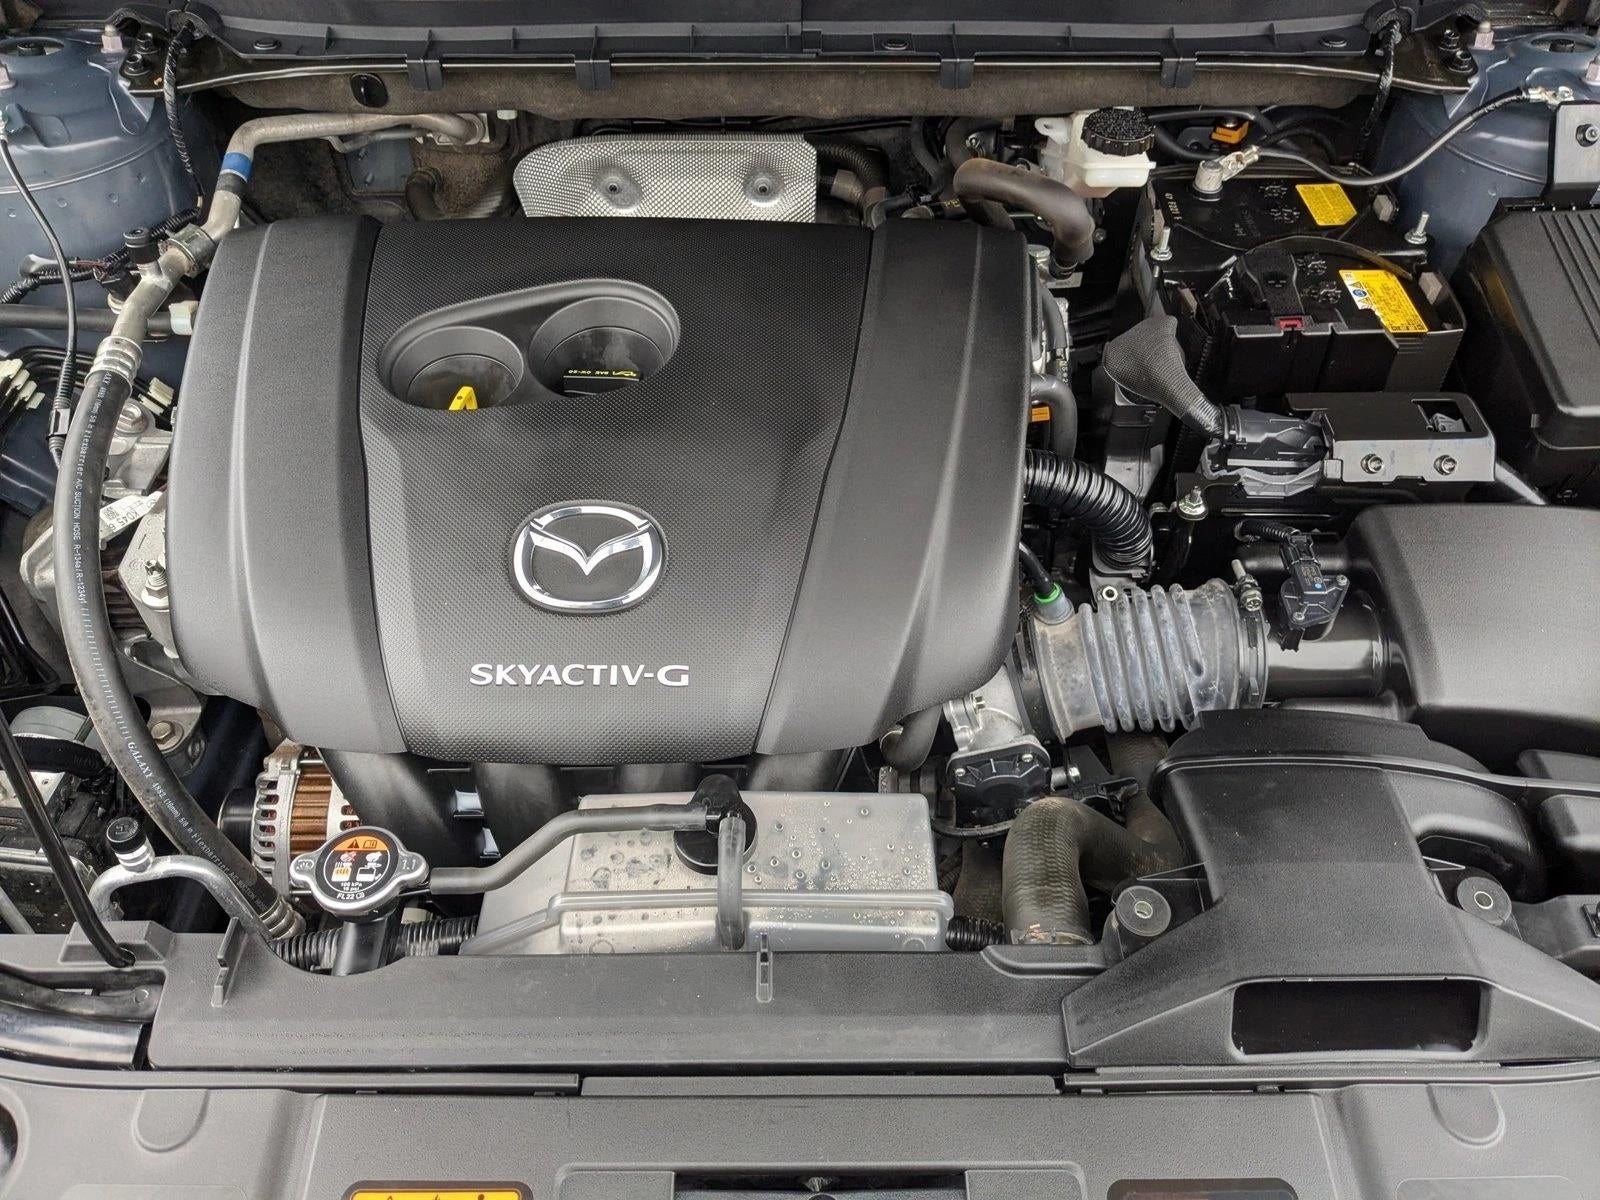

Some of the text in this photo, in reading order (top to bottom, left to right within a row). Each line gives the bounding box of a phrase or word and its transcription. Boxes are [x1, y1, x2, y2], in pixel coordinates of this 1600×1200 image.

[73, 491, 83, 519] SUCTION
[73, 522, 81, 541] HOSE
[469, 663, 690, 687] SKYACTIV-G
[127, 741, 153, 778] GALAXY
[402, 859, 416, 870] 1.1
[336, 892, 356, 900] FL22
